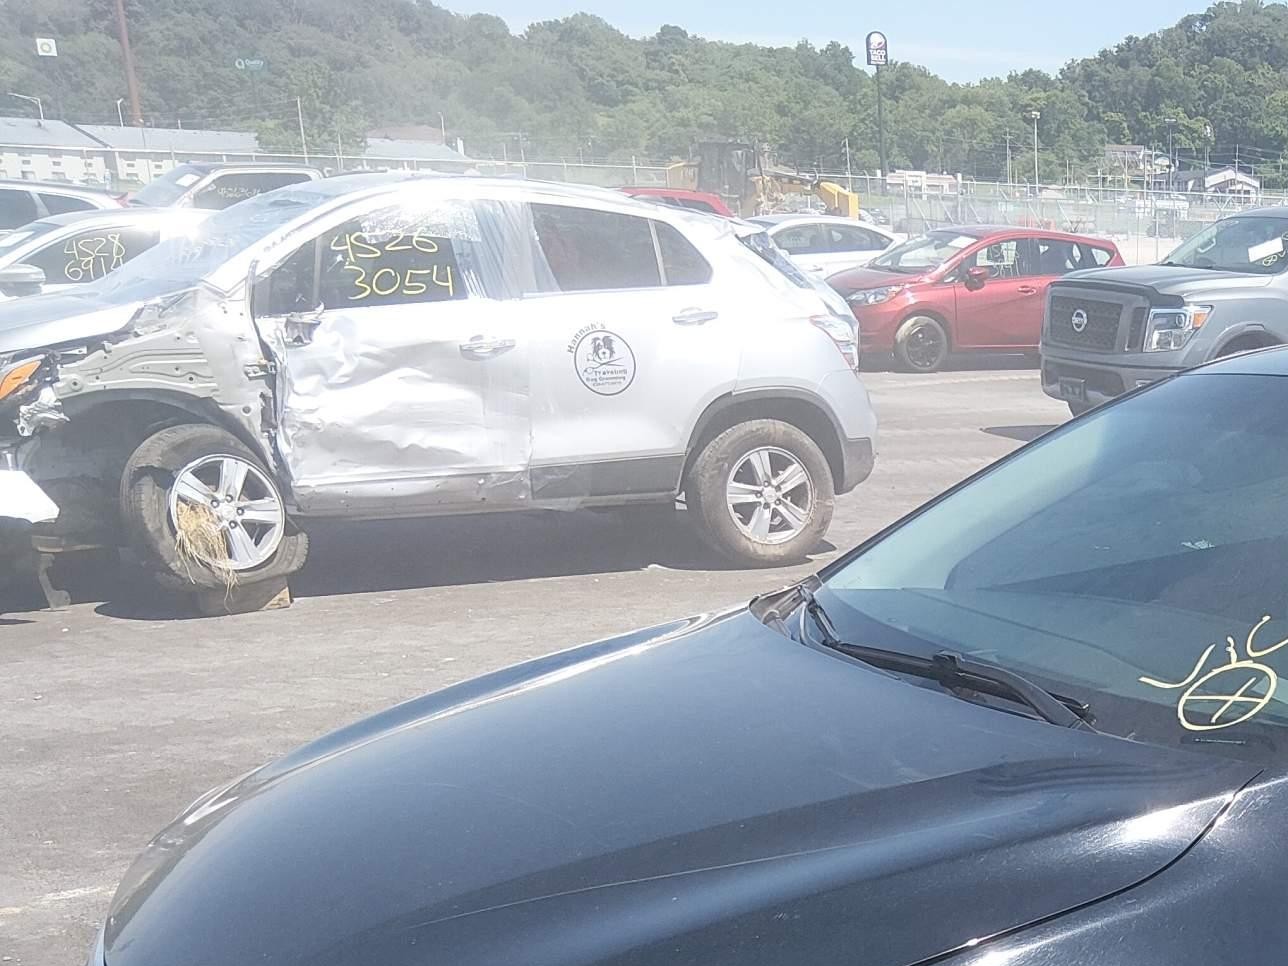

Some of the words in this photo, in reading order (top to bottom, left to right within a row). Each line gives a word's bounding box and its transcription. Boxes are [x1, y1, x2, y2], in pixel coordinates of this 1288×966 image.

[63, 233, 126, 260] 4528
[330, 228, 439, 262] 4526
[343, 264, 454, 300] 3054
